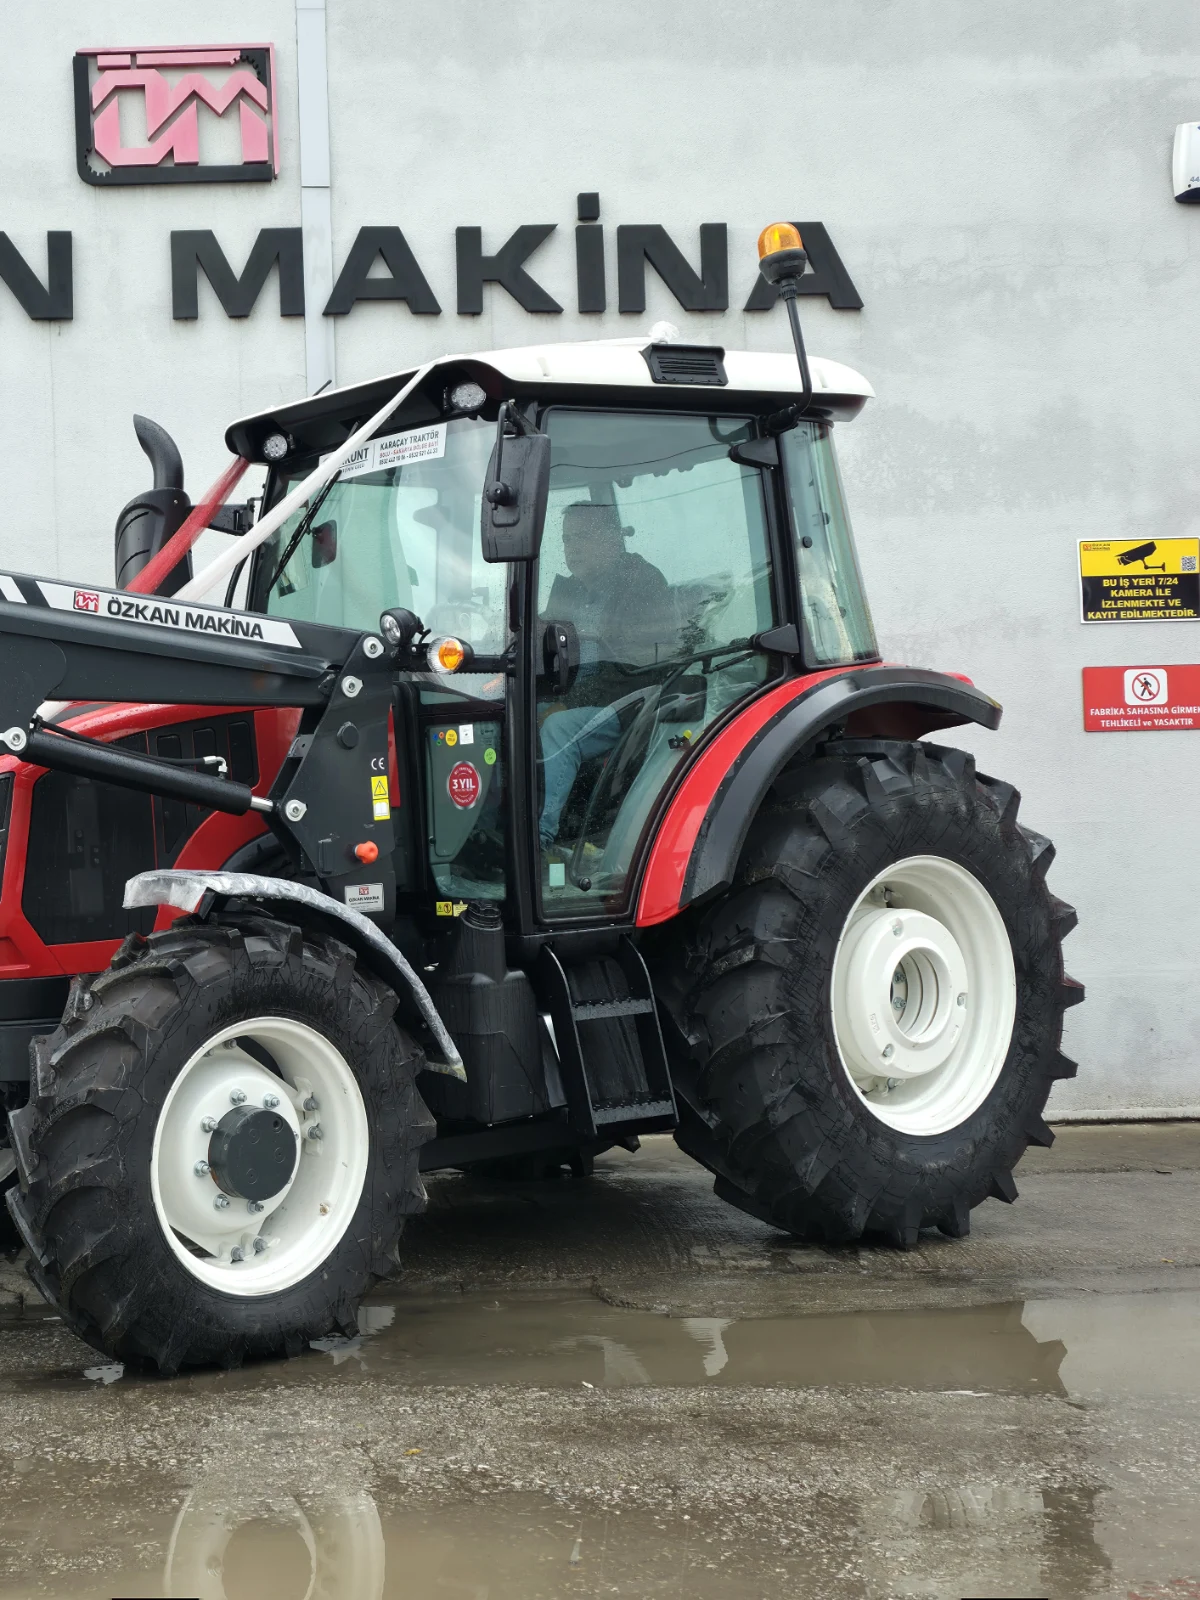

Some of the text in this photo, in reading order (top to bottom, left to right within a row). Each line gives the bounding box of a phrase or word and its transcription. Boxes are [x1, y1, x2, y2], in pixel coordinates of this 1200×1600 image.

[170, 192, 864, 320] MAKİNA
[380, 430, 439, 451] KARAÇAY TRAKTÖR
[1102, 576, 1179, 588] BU İŞ YERİ 7/24
[1110, 587, 1172, 597] KAMERA İLE
[1101, 599, 1182, 609] İZLENMEKTE VE
[107, 596, 180, 627] ÖZKAN
[185, 610, 264, 640] MAKİNA
[1087, 608, 1198, 619] KAYIT EDİLMEKTEDİR.
[1090, 707, 1125, 716] FABRİKA
[1126, 706, 1170, 715] SAHASINA
[1101, 718, 1141, 727] TEHLİKELİ
[1153, 717, 1194, 726] YASAKTIR
[371, 757, 385, 770] CE
[452, 778, 476, 789] 3 YIL
